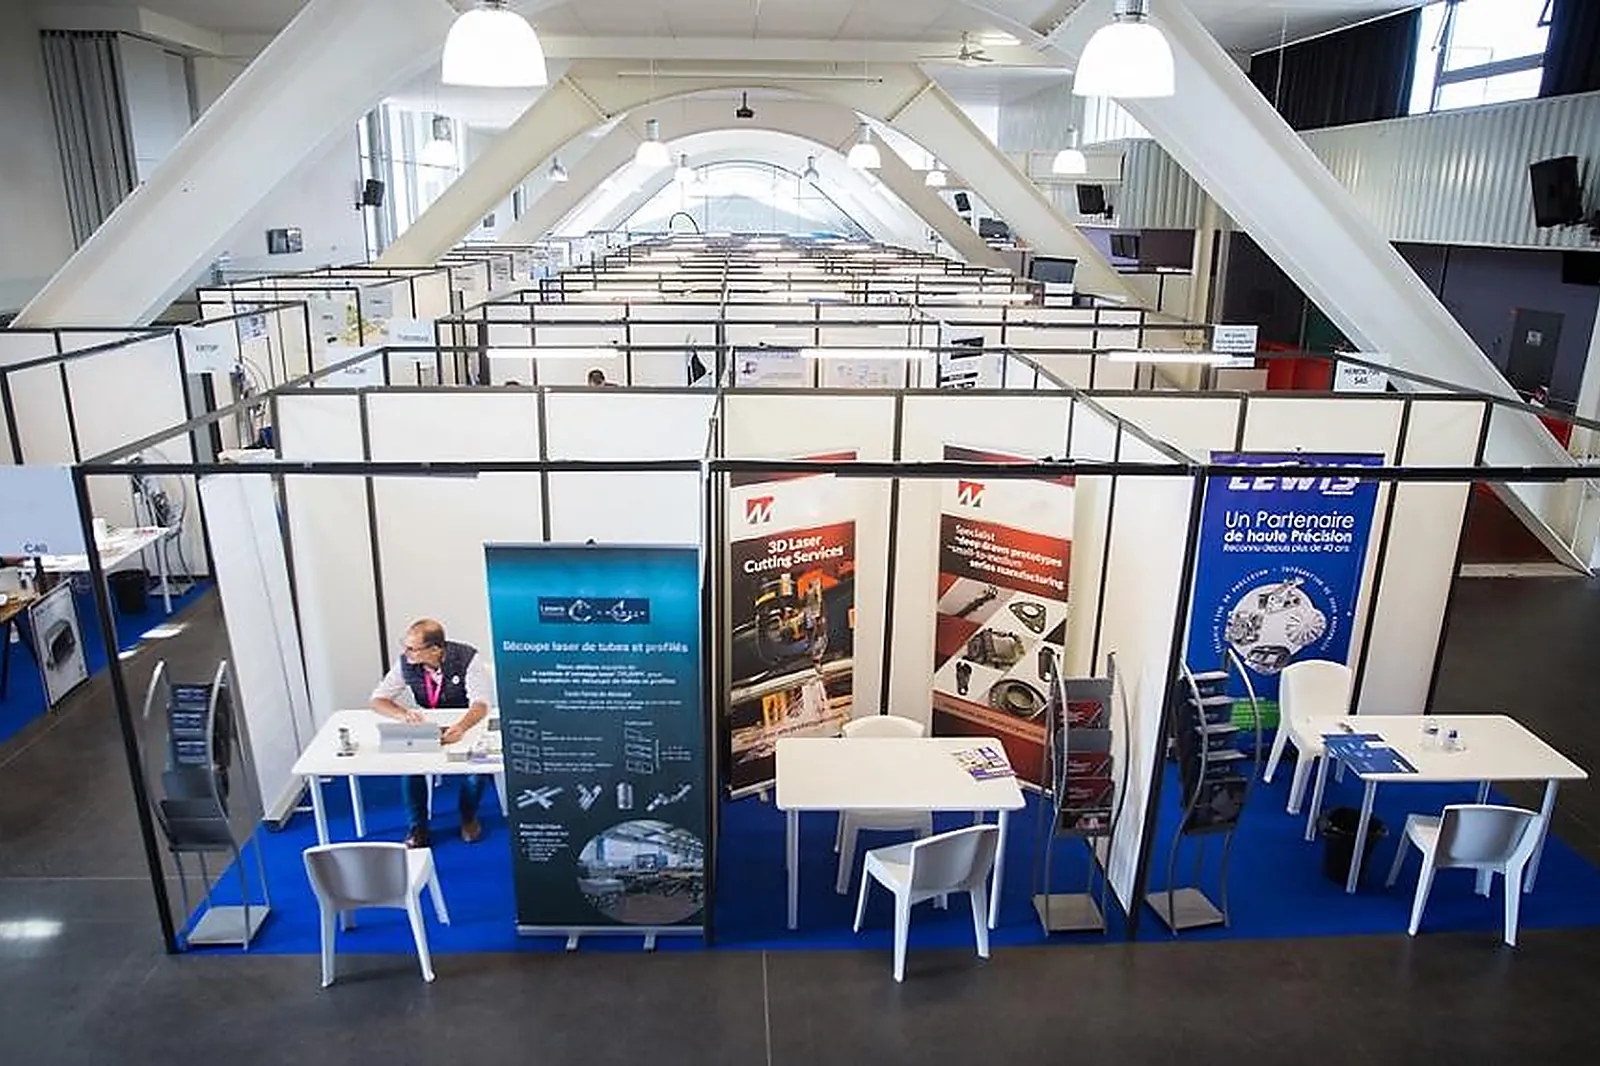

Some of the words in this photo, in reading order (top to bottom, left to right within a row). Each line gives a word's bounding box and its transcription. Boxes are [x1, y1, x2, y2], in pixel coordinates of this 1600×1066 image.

[1225, 511, 1250, 528] Un
[1256, 510, 1355, 528] Partenaire
[1224, 530, 1244, 543] de
[1247, 529, 1287, 543] haute
[1291, 528, 1352, 543] Précision
[768, 540, 787, 555] 3D
[789, 536, 822, 550] Laser
[1309, 544, 1321, 553] de
[744, 555, 793, 573] Cutting
[794, 546, 844, 564] Services
[1010, 549, 1062, 568] prototypes
[997, 565, 1064, 591] manufacturing
[503, 640, 550, 653] Découpe
[551, 641, 580, 651] laser
[581, 641, 597, 652] de
[598, 641, 630, 652] tubes
[632, 642, 644, 652] et
[645, 641, 689, 654] profilés
